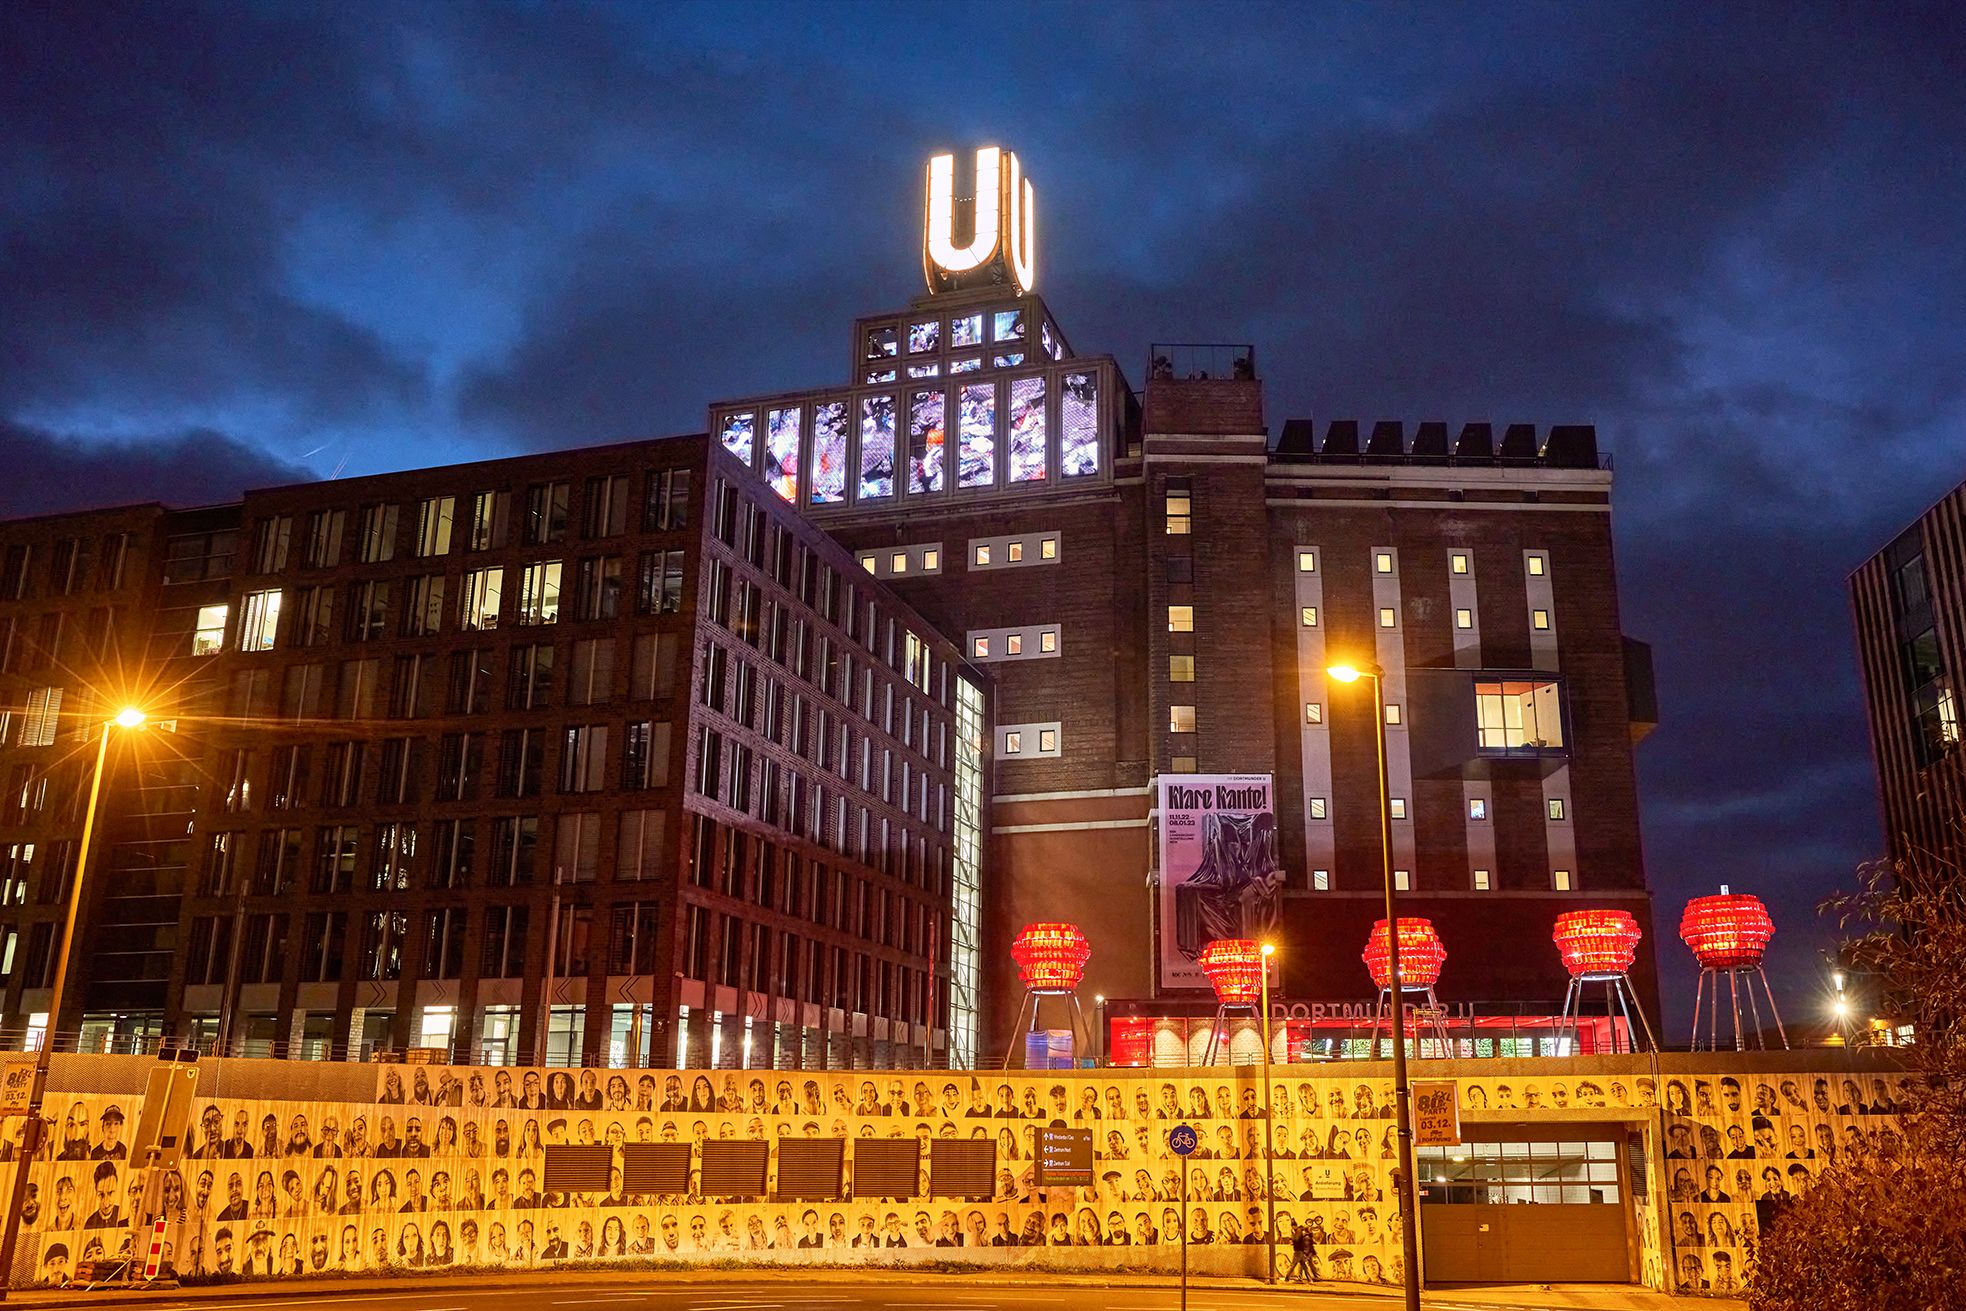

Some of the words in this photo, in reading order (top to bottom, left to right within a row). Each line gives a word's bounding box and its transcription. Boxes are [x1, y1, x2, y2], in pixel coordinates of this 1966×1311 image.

[928, 147, 1000, 271] U
[1168, 785, 1212, 809] Klare
[1216, 785, 1267, 809] Kante!
[1459, 1003, 1474, 1020] U
[1424, 1107, 1447, 1115] PARTY
[1421, 1118, 1452, 1130] 03.12.
